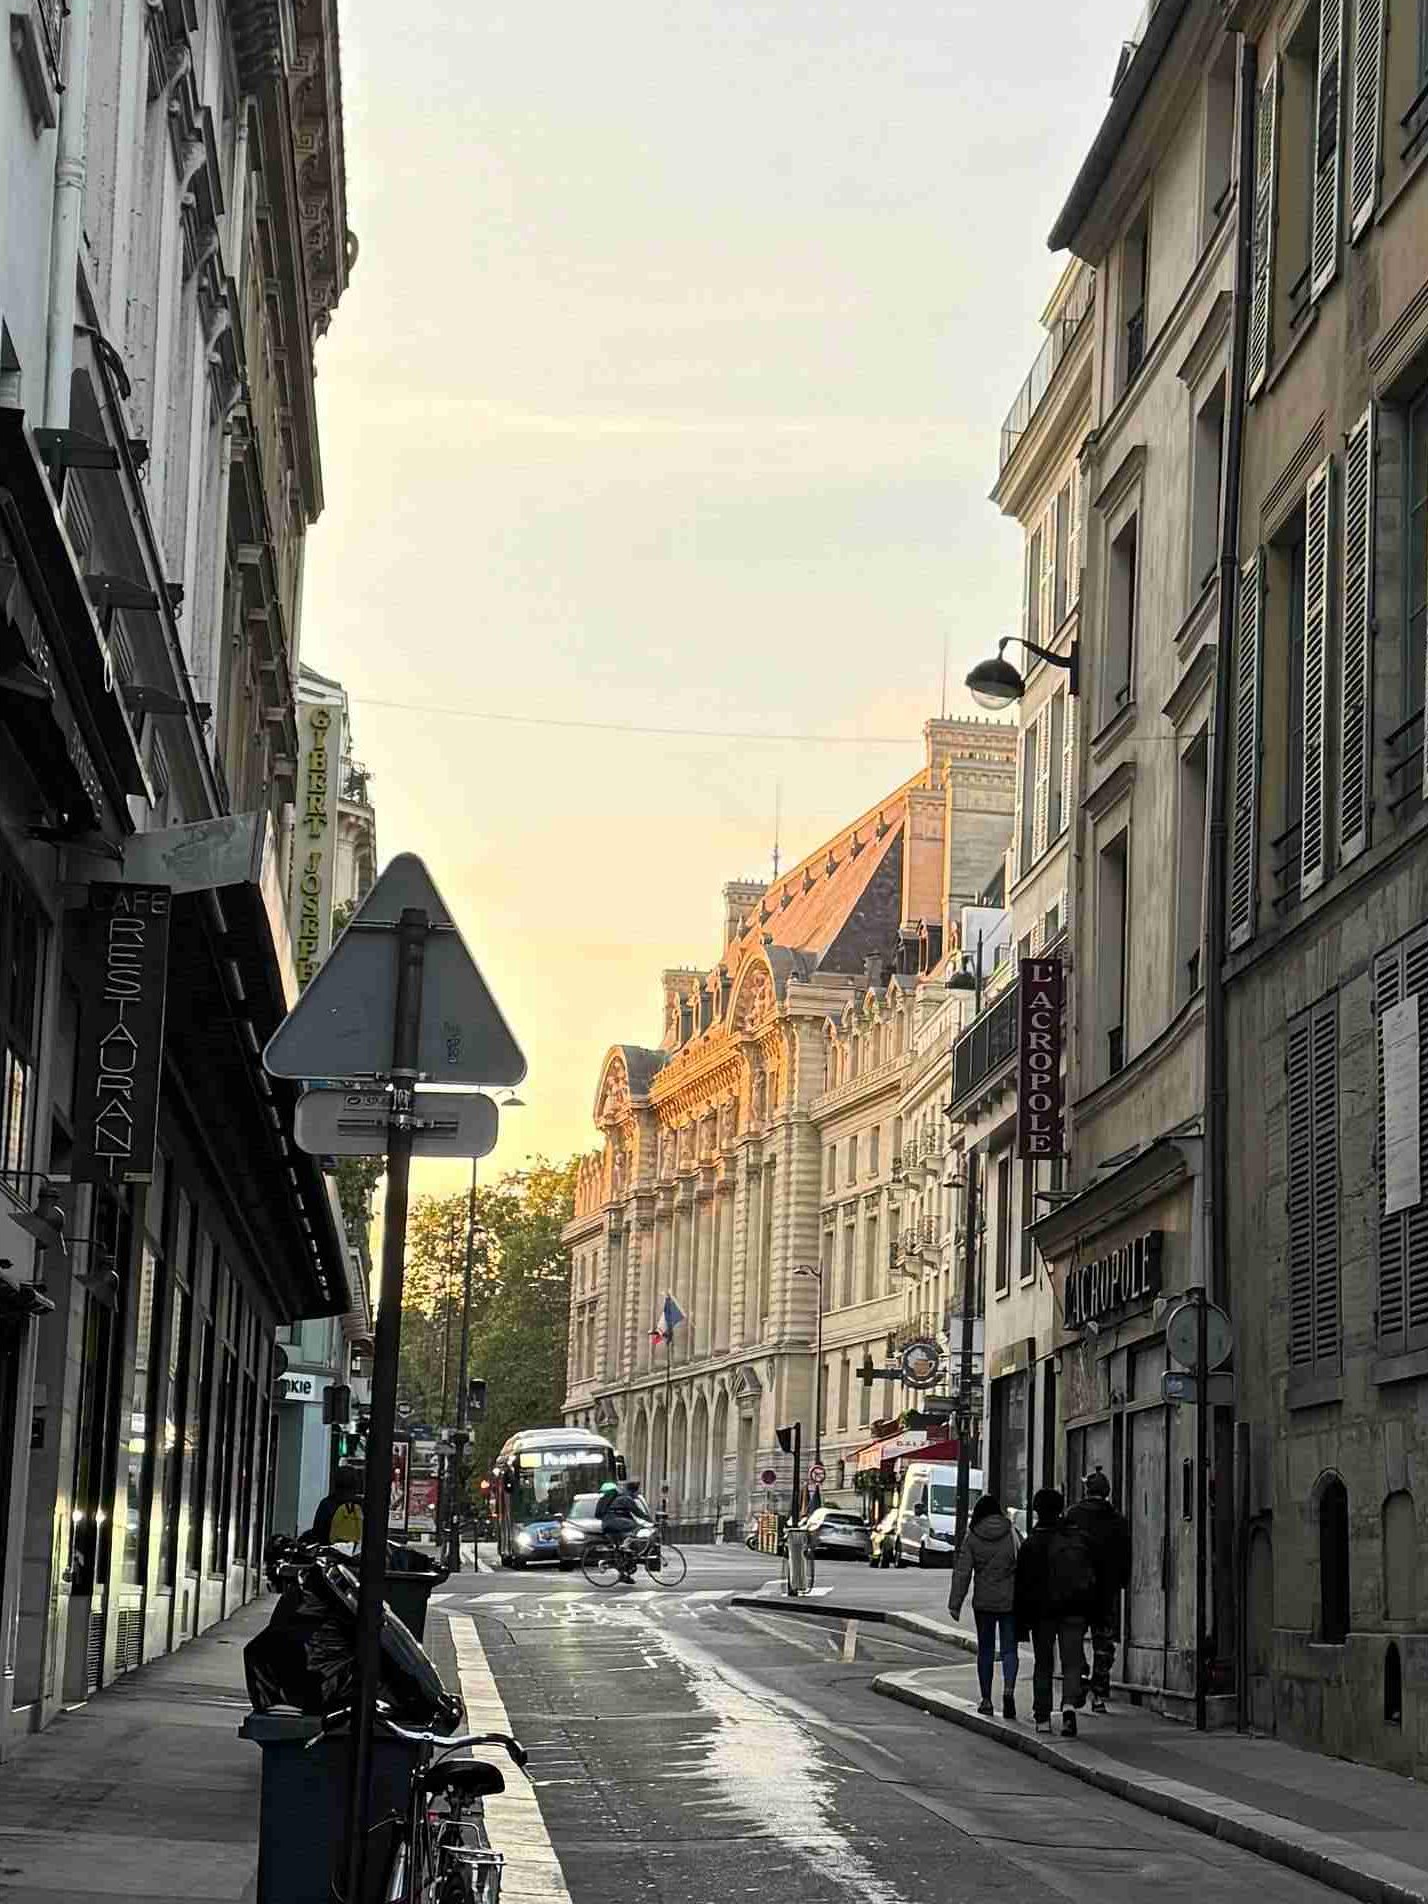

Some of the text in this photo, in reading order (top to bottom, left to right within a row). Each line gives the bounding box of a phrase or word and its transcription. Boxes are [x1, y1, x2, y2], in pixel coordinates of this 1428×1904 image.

[302, 707, 332, 838] GIBERT
[93, 917, 147, 1177] RESTAURANT
[1028, 964, 1055, 1153] L'ACROPOLE
